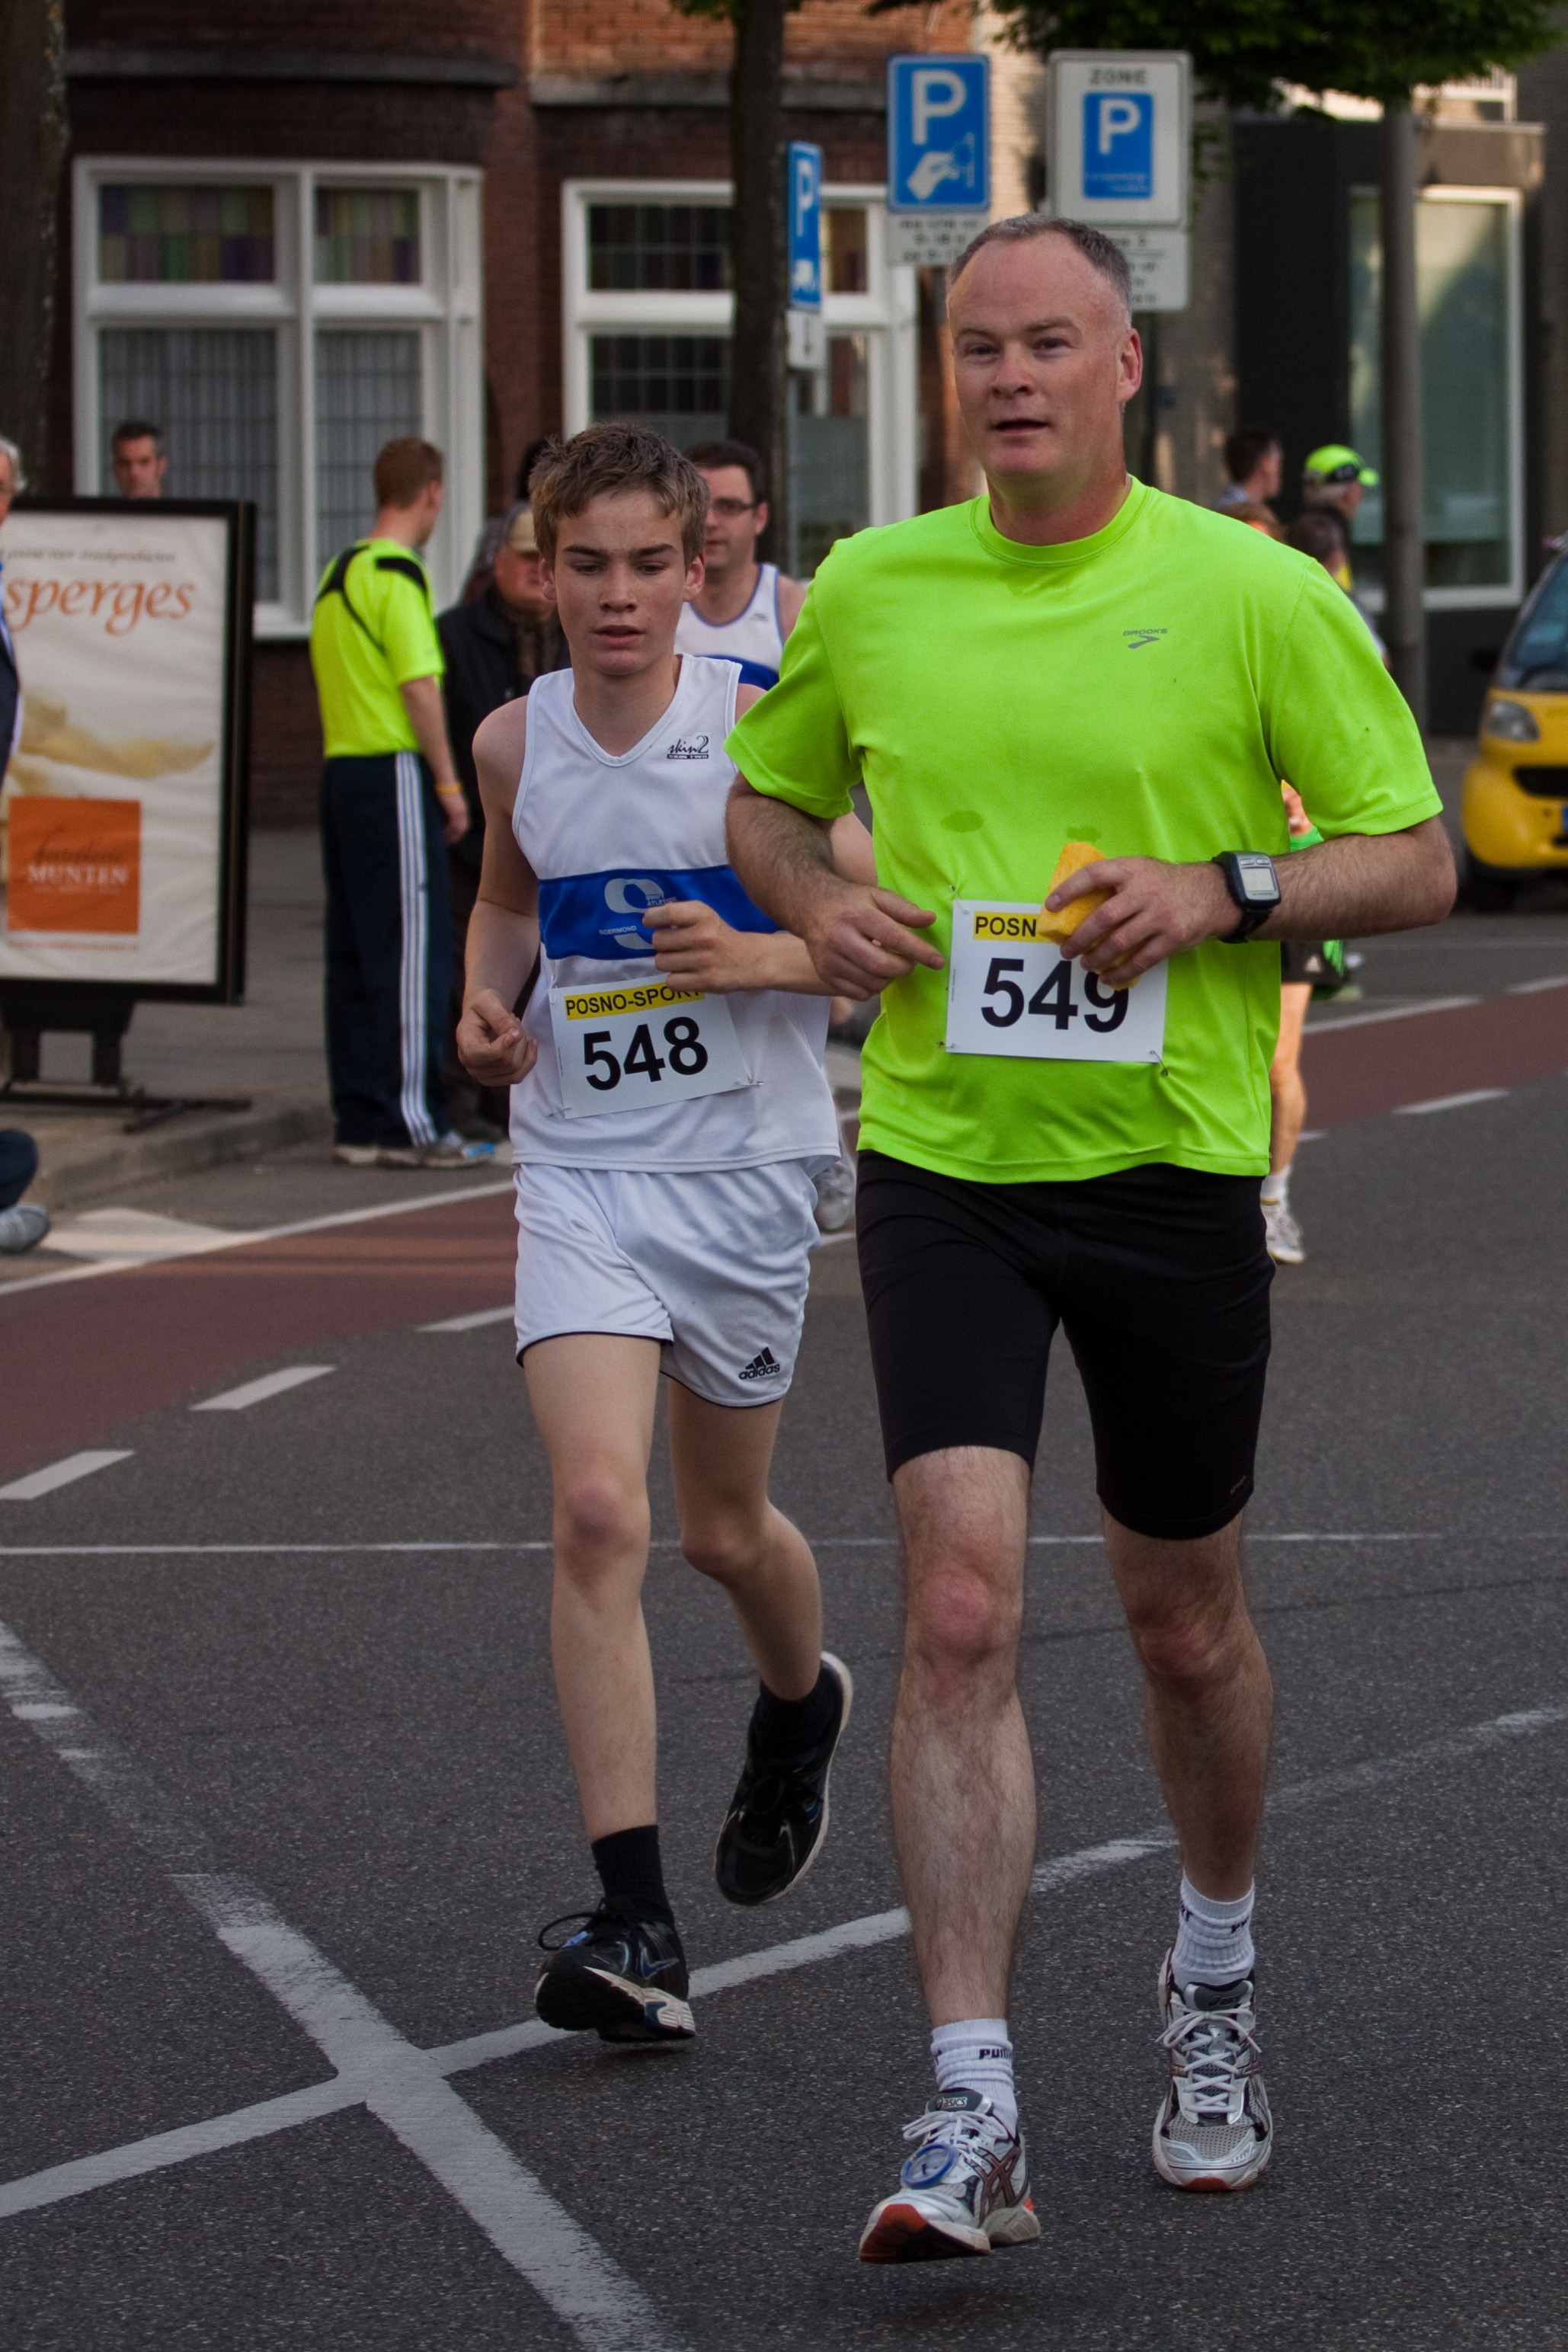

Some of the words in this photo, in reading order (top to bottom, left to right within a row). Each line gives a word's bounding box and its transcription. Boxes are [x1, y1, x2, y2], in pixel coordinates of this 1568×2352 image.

[1090, 69, 1147, 85] ZONE
[912, 69, 967, 146] P
[1099, 98, 1141, 155] P
[796, 158, 814, 238] P
[975, 917, 1037, 937] POSN
[565, 985, 699, 1016] POSNO-SPO
[981, 957, 1129, 1033] 549
[584, 1016, 709, 1090] 548
[738, 1363, 780, 1380] adidas
